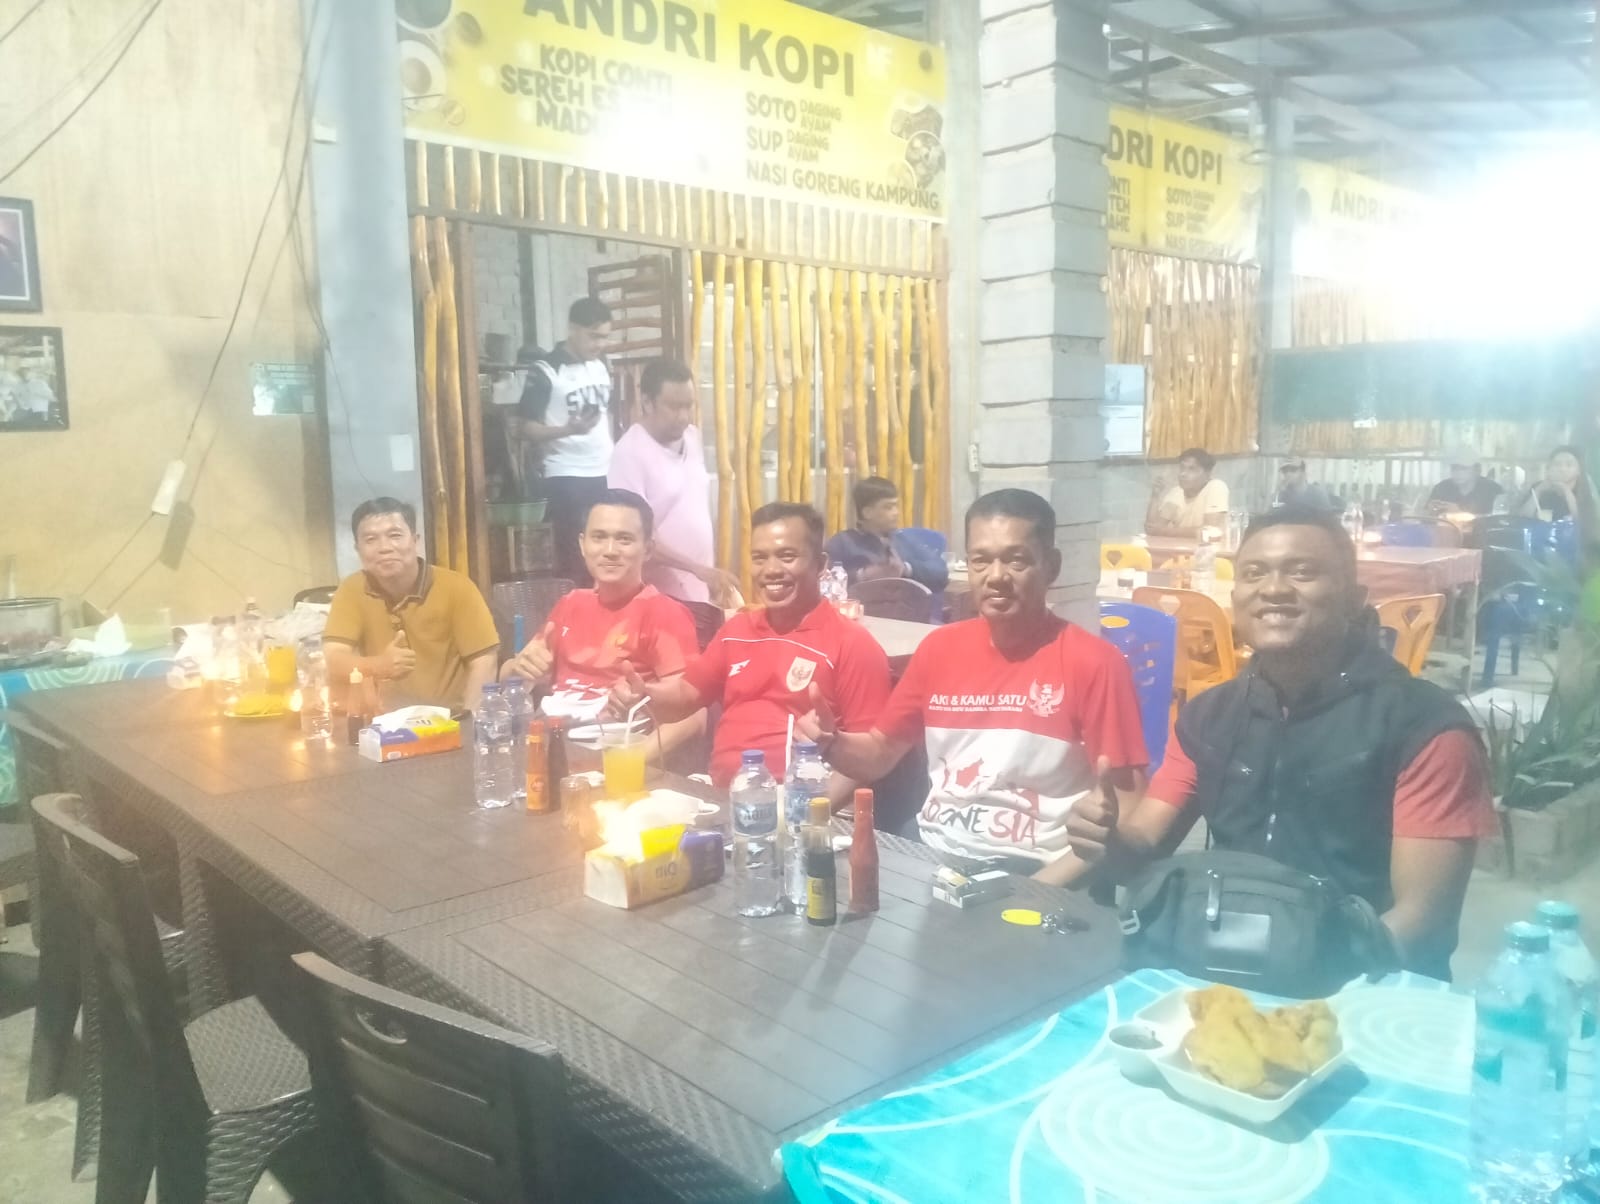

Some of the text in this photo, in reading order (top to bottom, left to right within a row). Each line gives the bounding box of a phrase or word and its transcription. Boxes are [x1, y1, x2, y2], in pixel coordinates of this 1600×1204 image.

[539, 43, 597, 81] KOPI
[738, 22, 855, 97] KOPI
[500, 63, 585, 106] SEREH
[535, 99, 608, 137] MAD
[745, 90, 797, 124] SOTO
[799, 98, 843, 122] DAGING
[800, 114, 832, 134] AYAM
[745, 125, 783, 152] SUP
[786, 128, 830, 152] DAGING
[787, 144, 819, 164] AYAM
[1107, 124, 1223, 185] DRI KOPI
[746, 159, 940, 211] NASI GORENG KAMPUNG
[1166, 186, 1193, 207] SOTO
[1166, 210, 1185, 228] SUP
[959, 694, 996, 706] KAMU
[997, 693, 1028, 706] SATU
